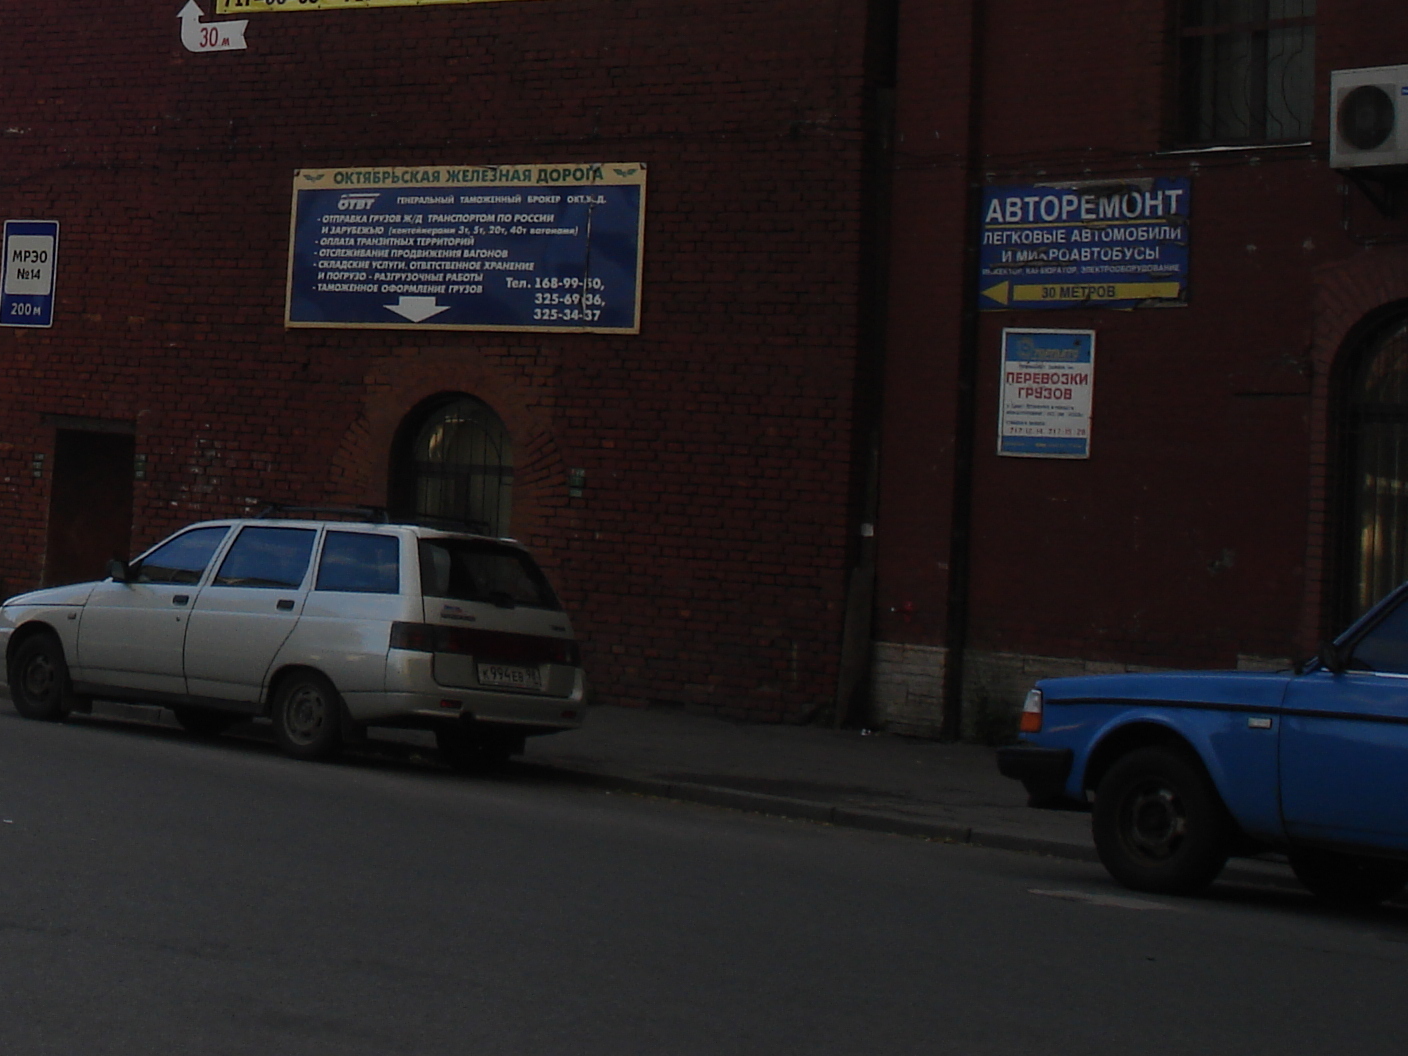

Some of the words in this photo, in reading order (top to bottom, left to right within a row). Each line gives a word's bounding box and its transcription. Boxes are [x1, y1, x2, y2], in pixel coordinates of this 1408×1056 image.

[199, 27, 219, 48] 30
[333, 170, 441, 185] ОКТЯБРЬСКАЯ
[446, 169, 532, 183] ЖЕЛЕЗНАЯ
[536, 167, 604, 184] ДОРОГА
[396, 194, 455, 205] ГЕНЕРАЛЬНЫЙ
[460, 194, 522, 204] ТАМОЖЕННЫЙ
[527, 195, 561, 204] БРОКЕР
[985, 190, 1183, 223] АВТОРЕМОНТ
[322, 214, 367, 224] ОТПРАВКА
[369, 214, 401, 224] ГРУЗОВ
[403, 214, 423, 225] Ж/Д
[427, 213, 495, 224] ТРАНСПОРТОМ
[497, 213, 512, 223] ПО
[514, 213, 555, 223] РОССИИ
[321, 226, 329, 235] И
[330, 226, 385, 235] ЗАРУБЕЖЬЮ
[983, 229, 1066, 245] ЛЕГКОВЫЕ
[1071, 226, 1181, 243] АВТОМОБИЛИ
[320, 237, 355, 246] ОПЛАТА
[356, 237, 414, 247] ТРАНЗИТНЫХ
[417, 235, 475, 246] ТЕРРИТОРИЙ
[12, 250, 48, 263] МРЭО
[319, 249, 389, 258] ОТСЛЕЖИВАНИЕ
[391, 249, 462, 259] ПРОДВИЖЕНИЯ
[463, 249, 509, 258] ВАГОНОВ
[1002, 250, 1012, 262] И
[318, 260, 369, 270] СКЛАДСКИЕ
[409, 261, 481, 271] ОТВЕТСТВЕННОЕ
[483, 262, 535, 272] ХРАНЕНИЕ
[17, 268, 41, 280] №14
[317, 272, 325, 281] И
[326, 272, 367, 282] ПОГРУЗО
[374, 273, 444, 283] РАЗГРУЗОЧНЫЕ
[445, 273, 484, 283] РАБОТЫ
[318, 284, 379, 293] ТАМОЖЕННОЕ
[381, 284, 446, 294] ОФОРМЛЕНИЕ
[448, 284, 483, 294] ГРУЗОВ
[506, 277, 531, 289] Тел.
[1042, 286, 1055, 298] 30
[1059, 286, 1115, 298] МЕТРОВ
[534, 293, 606, 307] 325-6936,
[10, 303, 32, 316] 200
[533, 308, 601, 321] 325-34-37
[1006, 372, 1088, 386] ПЕРЕВОЗКИ
[1018, 387, 1073, 400] ГРУЗОВ
